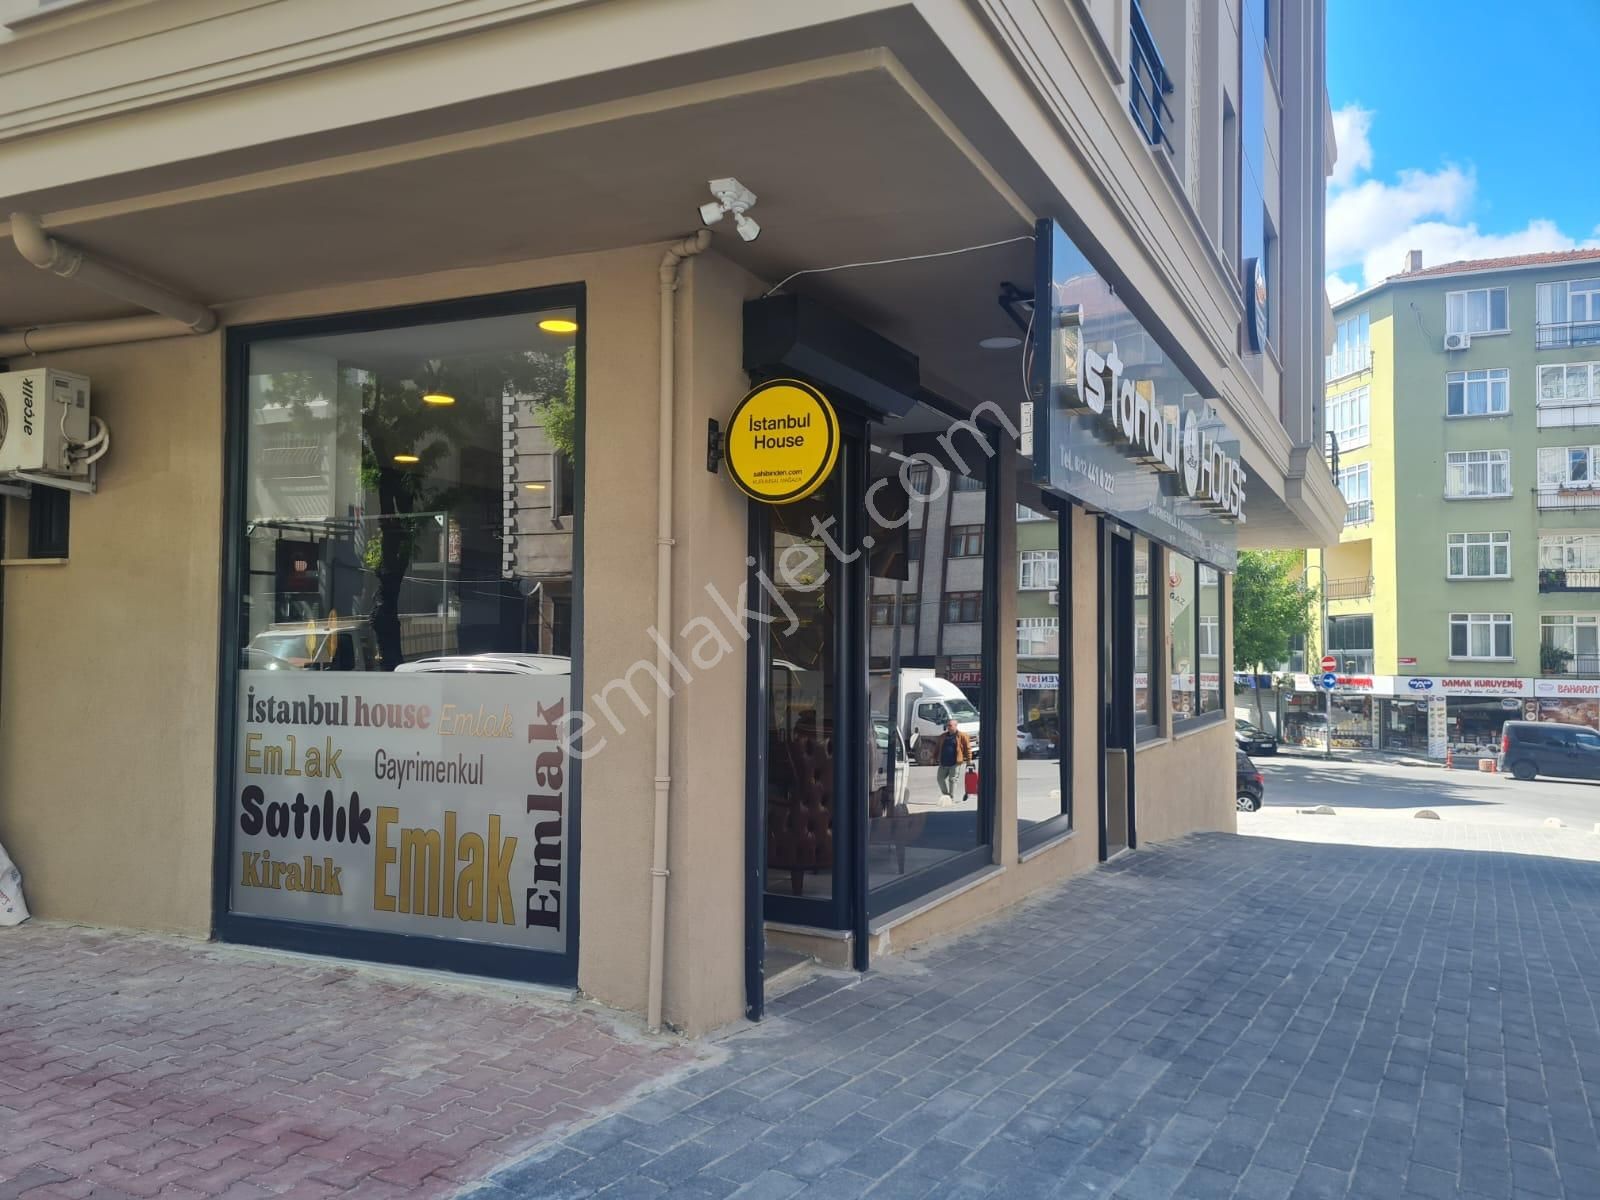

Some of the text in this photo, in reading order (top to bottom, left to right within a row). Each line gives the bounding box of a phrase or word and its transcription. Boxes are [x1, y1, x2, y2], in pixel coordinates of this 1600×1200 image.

[22, 378, 35, 435] arçelik
[749, 413, 810, 431] İstanbul
[754, 434, 804, 449] House
[1201, 430, 1247, 524] HOUSE
[1441, 680, 1472, 688] DAMAK
[1474, 678, 1523, 690] KURUYEMİŞ
[1557, 684, 1600, 695] BAHARAT
[246, 686, 432, 729] İstanbul house
[437, 703, 513, 738] Emlak
[244, 732, 343, 779] Emlak
[374, 748, 484, 789] Gayrimenkul
[240, 784, 372, 845] Satılık
[526, 697, 566, 932] Emlak
[240, 850, 343, 896] Kiralık
[373, 806, 518, 926] Emlak
